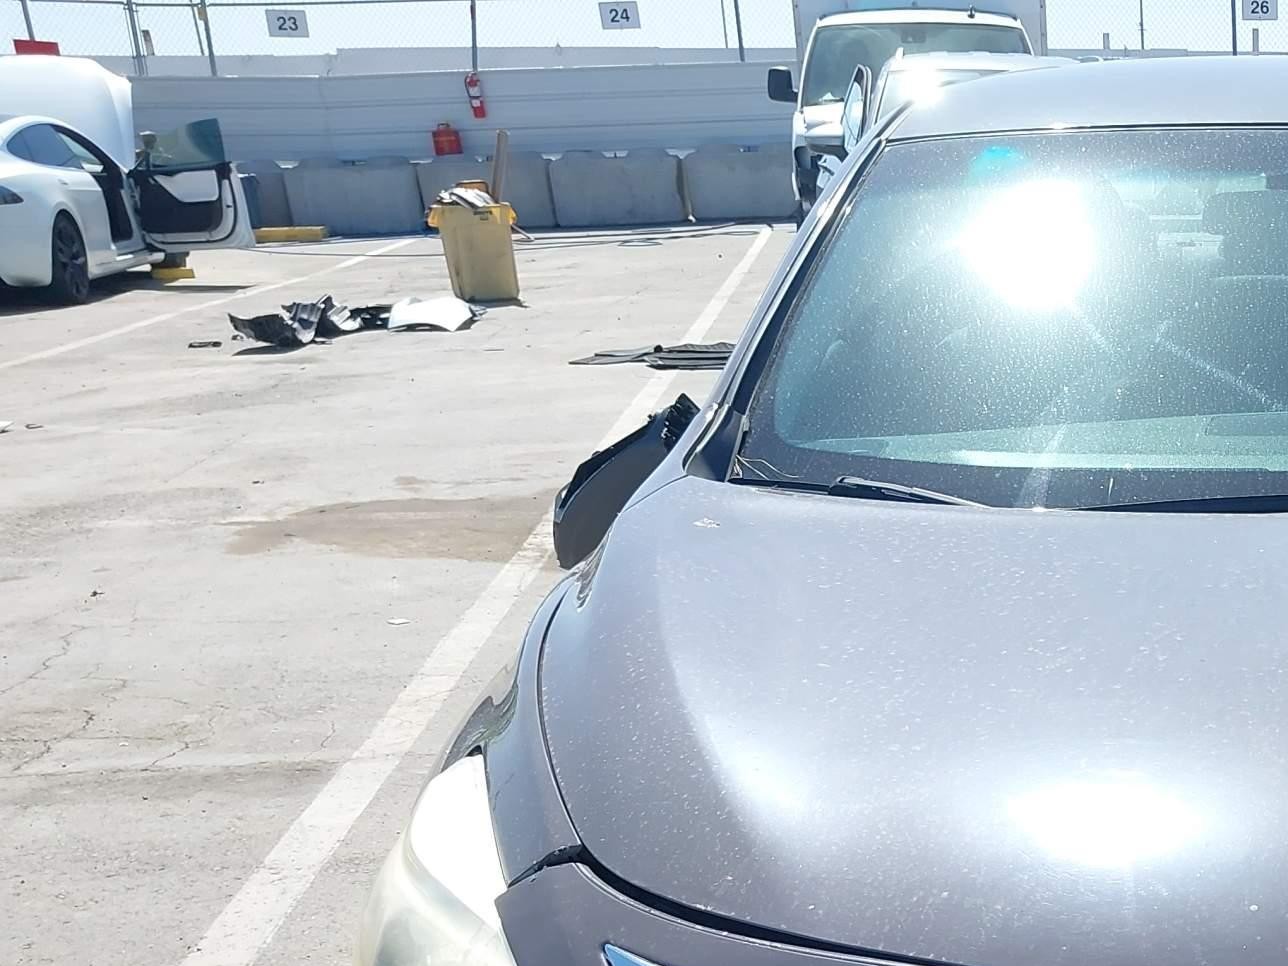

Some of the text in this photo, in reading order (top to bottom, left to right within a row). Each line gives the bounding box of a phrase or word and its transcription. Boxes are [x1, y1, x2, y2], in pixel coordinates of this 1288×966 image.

[1250, 0, 1269, 14] 26
[609, 8, 630, 23] 24
[276, 16, 298, 31] 23
